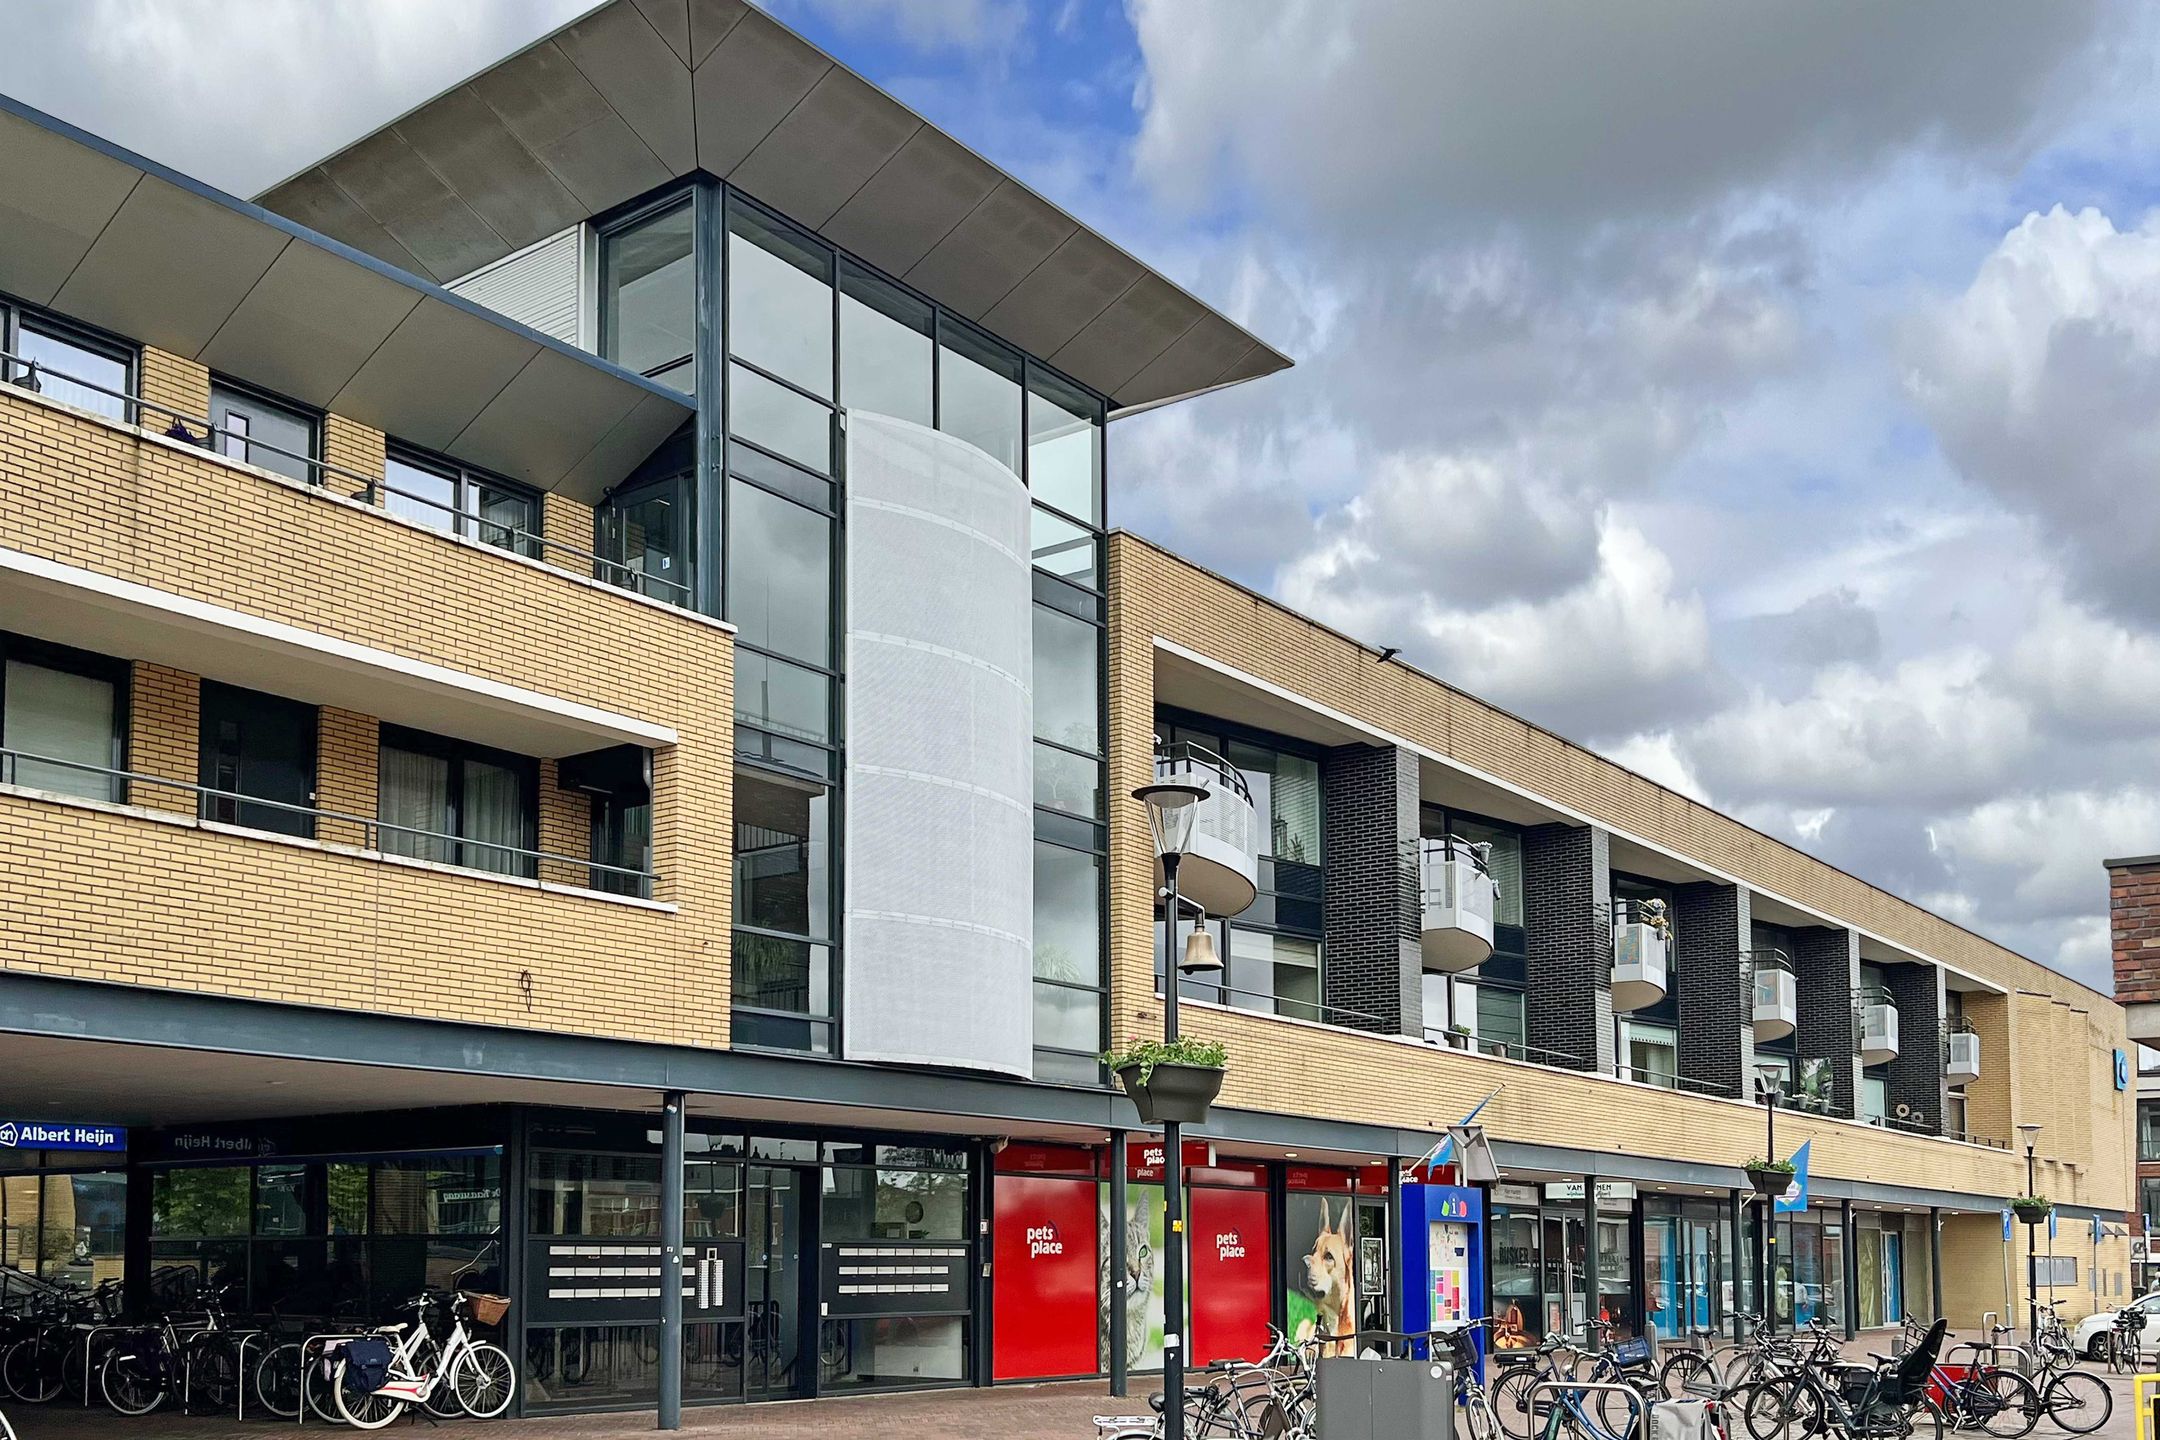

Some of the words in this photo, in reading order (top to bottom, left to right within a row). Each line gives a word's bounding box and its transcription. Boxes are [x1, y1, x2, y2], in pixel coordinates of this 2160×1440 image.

[20, 1127, 70, 1142] Albert
[75, 1129, 114, 1146] Heijn
[1143, 1148, 1163, 1160] pets
[1146, 1155, 1166, 1167] plac
[1027, 1225, 1054, 1245] pets
[1216, 1232, 1238, 1249] pets
[1031, 1240, 1063, 1259] place
[1220, 1245, 1245, 1262] place
